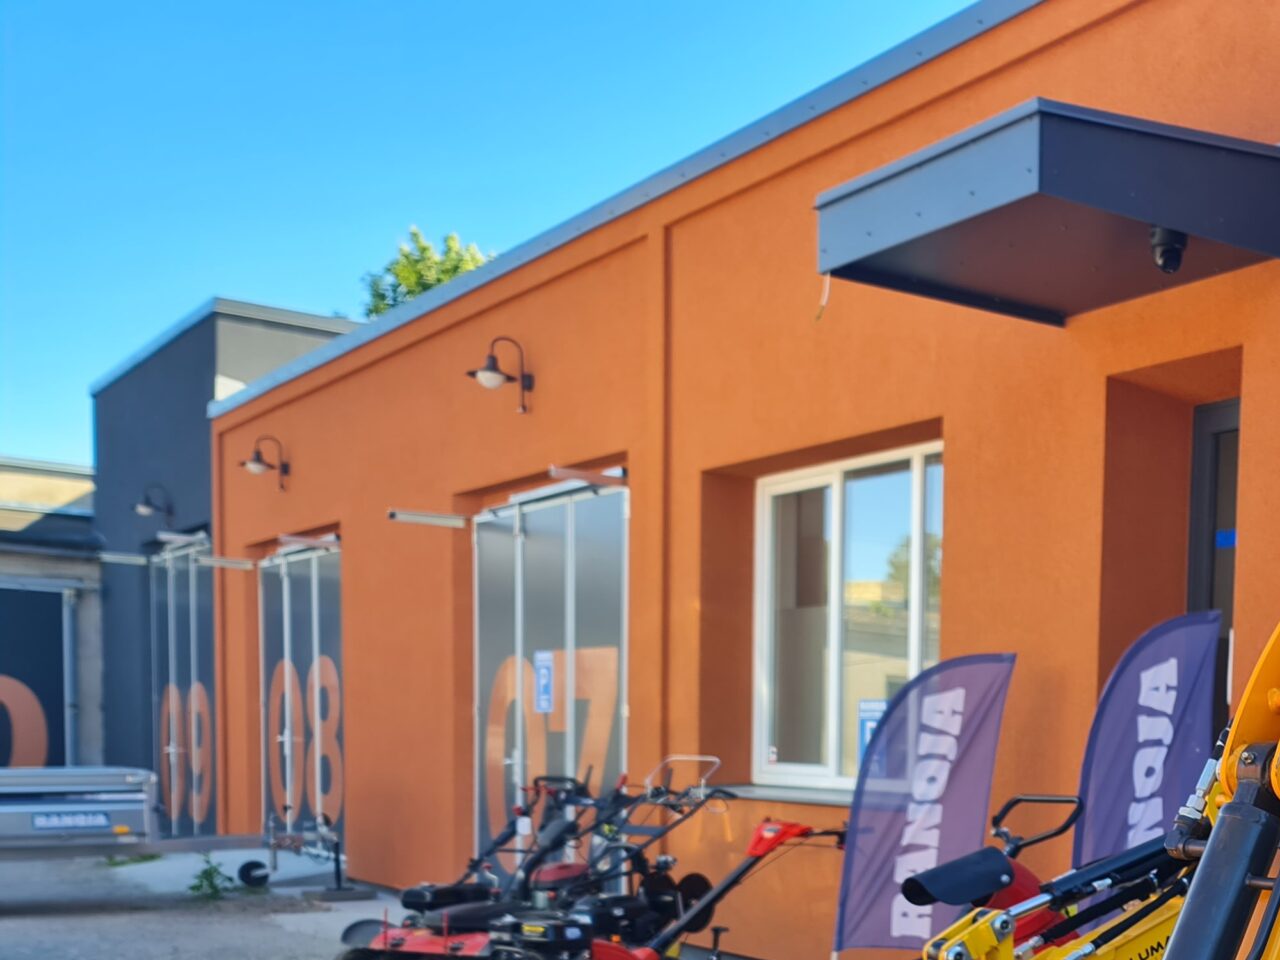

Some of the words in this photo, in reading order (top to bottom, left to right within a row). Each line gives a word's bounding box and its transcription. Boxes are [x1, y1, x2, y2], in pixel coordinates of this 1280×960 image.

[160, 680, 212, 824] 09
[268, 655, 343, 827] 08
[890, 687, 966, 939] RANOJA
[1127, 657, 1178, 848] NOJA
